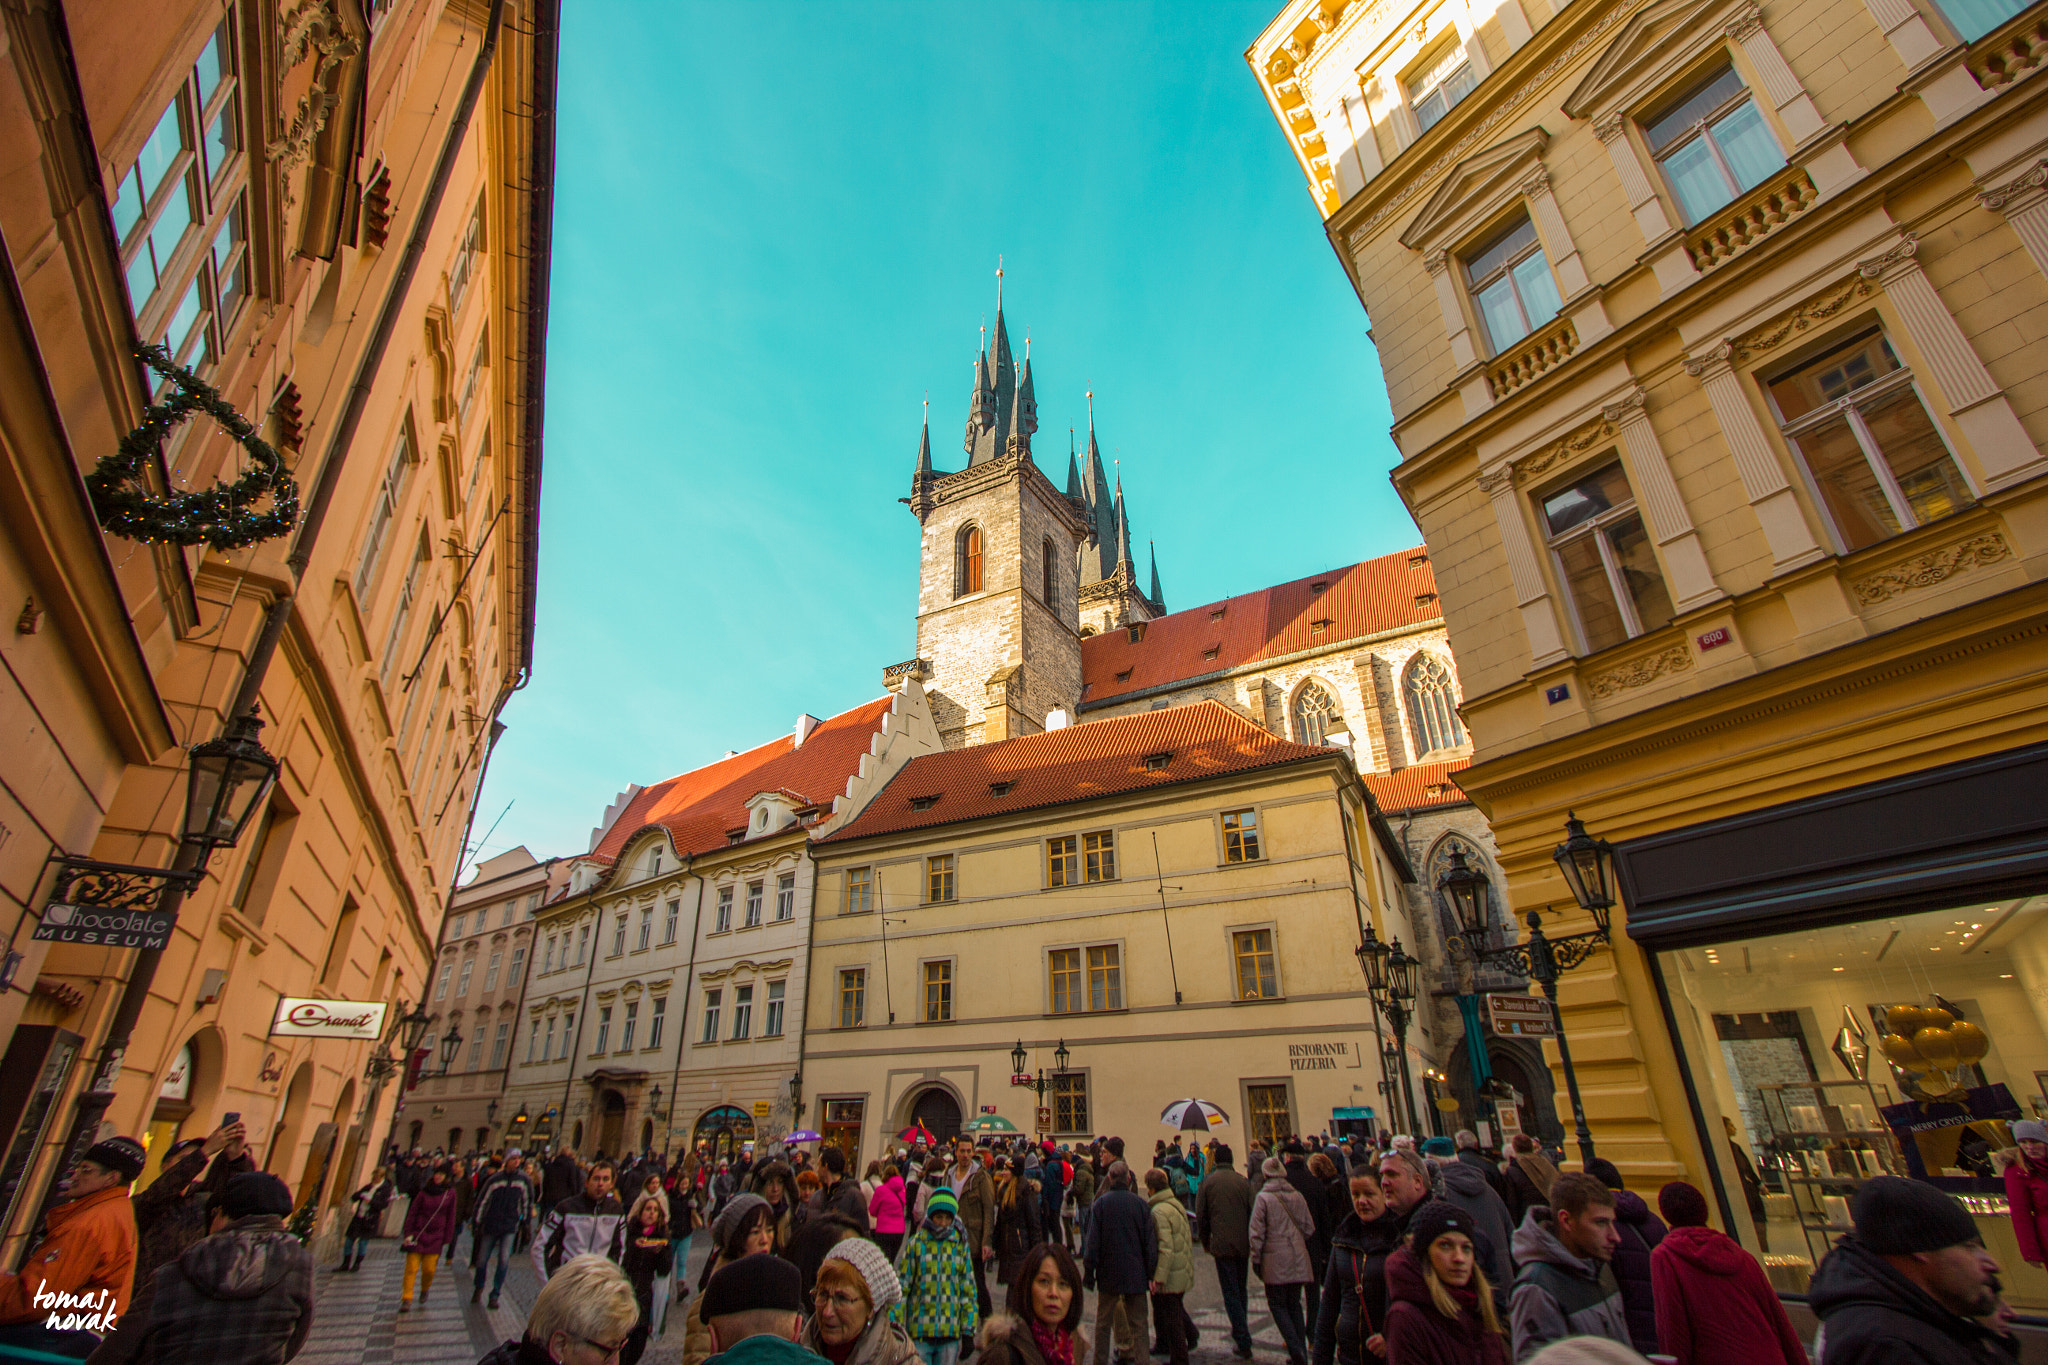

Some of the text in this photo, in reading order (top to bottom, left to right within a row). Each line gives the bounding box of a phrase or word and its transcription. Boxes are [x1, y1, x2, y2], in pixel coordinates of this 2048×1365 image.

[1703, 629, 1723, 645] 600
[47, 904, 168, 933] Chocolate
[35, 928, 163, 949] MUSEUM
[1288, 1042, 1348, 1056] RISTORANTE
[1290, 1057, 1337, 1070] PIZZERIA
[1910, 1114, 1976, 1133] MERRY CRYSTAL
